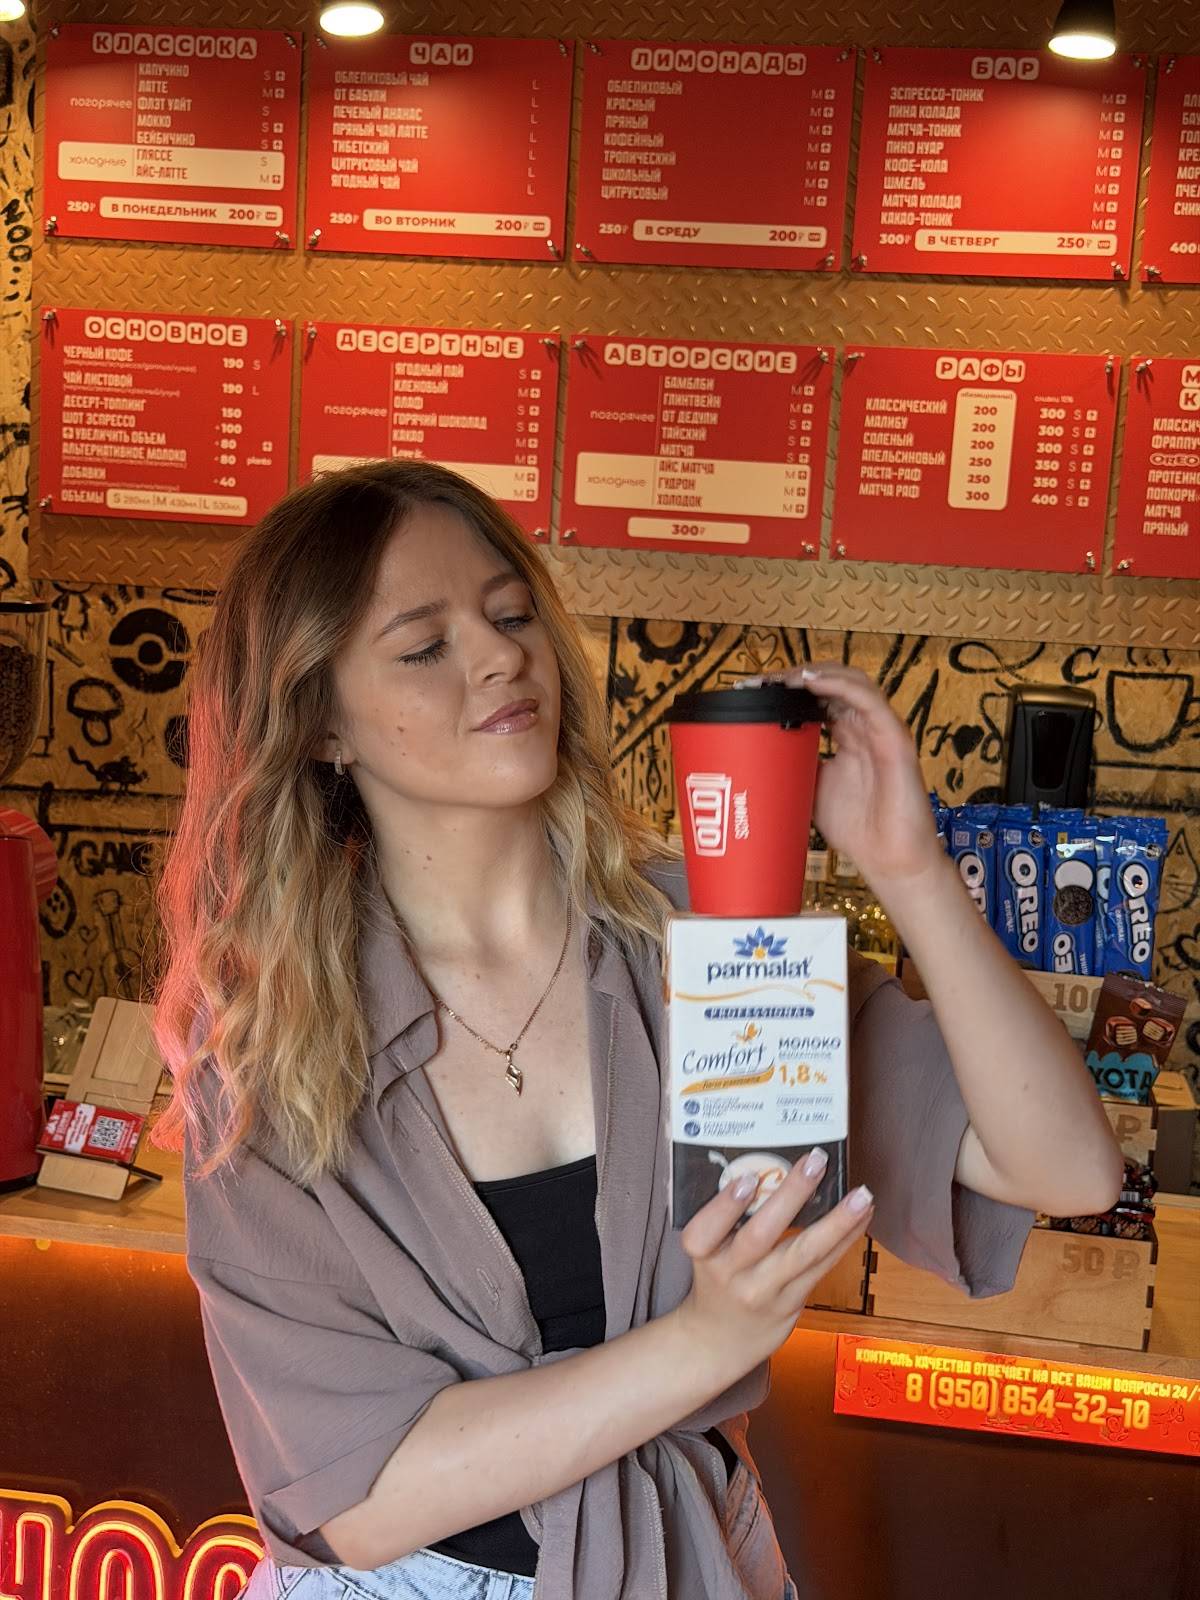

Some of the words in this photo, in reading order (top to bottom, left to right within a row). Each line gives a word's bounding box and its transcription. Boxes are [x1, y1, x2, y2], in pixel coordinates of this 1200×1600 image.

[94, 34, 257, 59] КЛАССИКА
[411, 43, 473, 65] ЧАИ
[631, 48, 806, 75] ЛИМОНАДЫ
[972, 57, 1039, 80] БАР
[139, 63, 189, 77] КАПУЧИНО
[138, 81, 168, 93] ЛАТТЕ
[607, 80, 682, 95] ОБЛЕПИХОВЫЙ
[334, 89, 346, 101] ОТ
[349, 89, 387, 103] БАБУЛИ
[889, 87, 984, 102] ЭСПРЕССО-ТОНИК
[70, 98, 132, 110] погорячее
[137, 99, 164, 111] ФЛЭТ
[167, 99, 192, 112] УАЙТ
[606, 98, 655, 112] КРАСНЫЙ
[333, 105, 382, 119] ПЕЧЕНЫЙ
[889, 105, 916, 118] ПИНА
[919, 106, 960, 120] КОЛАДА
[137, 115, 171, 128] МОККО
[605, 115, 648, 129] ПРЯНЫЙ
[333, 122, 375, 136] ПРЯНЫЙ
[396, 126, 428, 139] ЛАТТЕ
[887, 123, 961, 138] МАТЧА-ТОНИК
[137, 133, 195, 146] БЕЙБИЧИНО
[604, 133, 664, 147] КОФЕЙНЫЙ
[332, 140, 390, 154] ТИБЕТСКИЙ
[886, 141, 914, 154] ПИНО
[916, 141, 944, 155] НУАР
[69, 157, 127, 167] холодные
[137, 150, 172, 161] ГЛЯССЕ
[604, 151, 676, 165] ТРОПИЧЕСКИЙ
[332, 157, 397, 173] ЦИТРУСОВЫЙ
[885, 159, 948, 172] КОФЕ-КОЛА
[136, 166, 187, 180] АЙС-ЛАТТЕ
[602, 168, 661, 182] ШКОЛЬНЫЙ
[884, 176, 925, 190] ШМЕЛЬ
[601, 186, 668, 200] ЦИТРУСОВЫЙ
[882, 194, 918, 208] МАТЧА
[920, 195, 961, 209] КОЛАДА
[112, 204, 118, 212] В
[122, 204, 216, 218] ПОНЕДЕЛЬНИК
[375, 215, 392, 225] ВО
[396, 216, 455, 228] ВТОРНИК
[880, 212, 952, 226] КАКАО-ТОНИК
[645, 226, 654, 235] В
[656, 226, 700, 238] СРЕДУ
[927, 236, 936, 245] В
[940, 236, 1000, 247] ЧЕТВЕРГ
[85, 316, 247, 347] ОСНОВНОЕ
[337, 329, 523, 358] ДЕСЕРТНЫЕ
[63, 346, 104, 360] ЧЕРНЫЙ
[105, 348, 134, 362] КОФЕ
[604, 343, 797, 373] АВТОРСКИЕ
[223, 357, 244, 369] 190
[936, 357, 1026, 382] РАФЫ
[83, 372, 133, 387] ЛИСТОВОЙ
[222, 383, 243, 394] 190
[63, 395, 146, 411] ДЕСЕРТ-ТОППИНГ
[663, 393, 721, 408] ГЛИНТВЕЙН
[865, 398, 948, 414] КЛАССИЧЕСКИЙ
[222, 408, 242, 419] 150
[324, 406, 387, 417] погорячее
[590, 410, 655, 423] погорячее
[662, 410, 675, 423] ОТ
[677, 411, 718, 425] ДЕДУЛИ
[974, 406, 997, 416] 200
[1040, 408, 1066, 419] 300
[63, 411, 83, 424] ШОТ
[86, 413, 135, 428] ЭСПРЕССО
[864, 415, 908, 429] МАЛИБУ
[661, 427, 707, 441] ТАЙСКИЙ
[971, 423, 996, 433] 200
[1038, 426, 1064, 436] 300
[76, 428, 129, 442] УВЕЛИЧИТЬ
[131, 431, 166, 445] ОБЪЕМ
[863, 432, 913, 446] СОЛЕНЫЙ
[660, 444, 695, 457] МАТЧА
[970, 441, 994, 450] 200
[1037, 443, 1062, 454] 300
[862, 449, 946, 465] АПЕЛЬСИНОВЫЙ
[969, 458, 992, 467] 250
[659, 460, 678, 472] АЙС
[680, 463, 714, 475] МАТЧА
[1035, 460, 1060, 471] 350
[860, 466, 922, 482] РАСТА-РАФ
[968, 475, 990, 484] 250
[587, 476, 646, 488] холодные
[658, 478, 696, 490] ГУДРОН
[1033, 478, 1058, 488] 350
[859, 483, 894, 497] МАТЧА
[896, 485, 920, 498] РАФ
[966, 492, 989, 501] 300
[657, 494, 702, 507] ХОЛОДОК
[1032, 494, 1058, 505] 400
[1145, 505, 1182, 518] МАТЧА
[1143, 521, 1189, 537] ПРЯНЫЙ
[691, 788, 723, 849] OLD
[1011, 852, 1039, 953] OREO
[1123, 863, 1150, 963] OREO
[707, 956, 812, 985] parmalat
[779, 1037, 841, 1050] МОЛОКО
[682, 1044, 768, 1075] Comfort
[779, 1064, 810, 1087] 1,8
[1061, 1243, 1105, 1278] 50
[855, 1348, 913, 1367] КОНТРОЛЬ
[915, 1355, 972, 1374] КАЧЕСТВА
[974, 1362, 1030, 1381] ОТВЕЧАЕТ
[1032, 1370, 1049, 1382] НА
[1050, 1371, 1074, 1386] ВСЕ
[1076, 1375, 1111, 1389] ВАШИ
[1112, 1379, 1171, 1398] ВОПРОСЫ
[905, 1373, 923, 1402] 8
[930, 1371, 1000, 1417] (950)
[1003, 1387, 1151, 1430] 854-32-10
